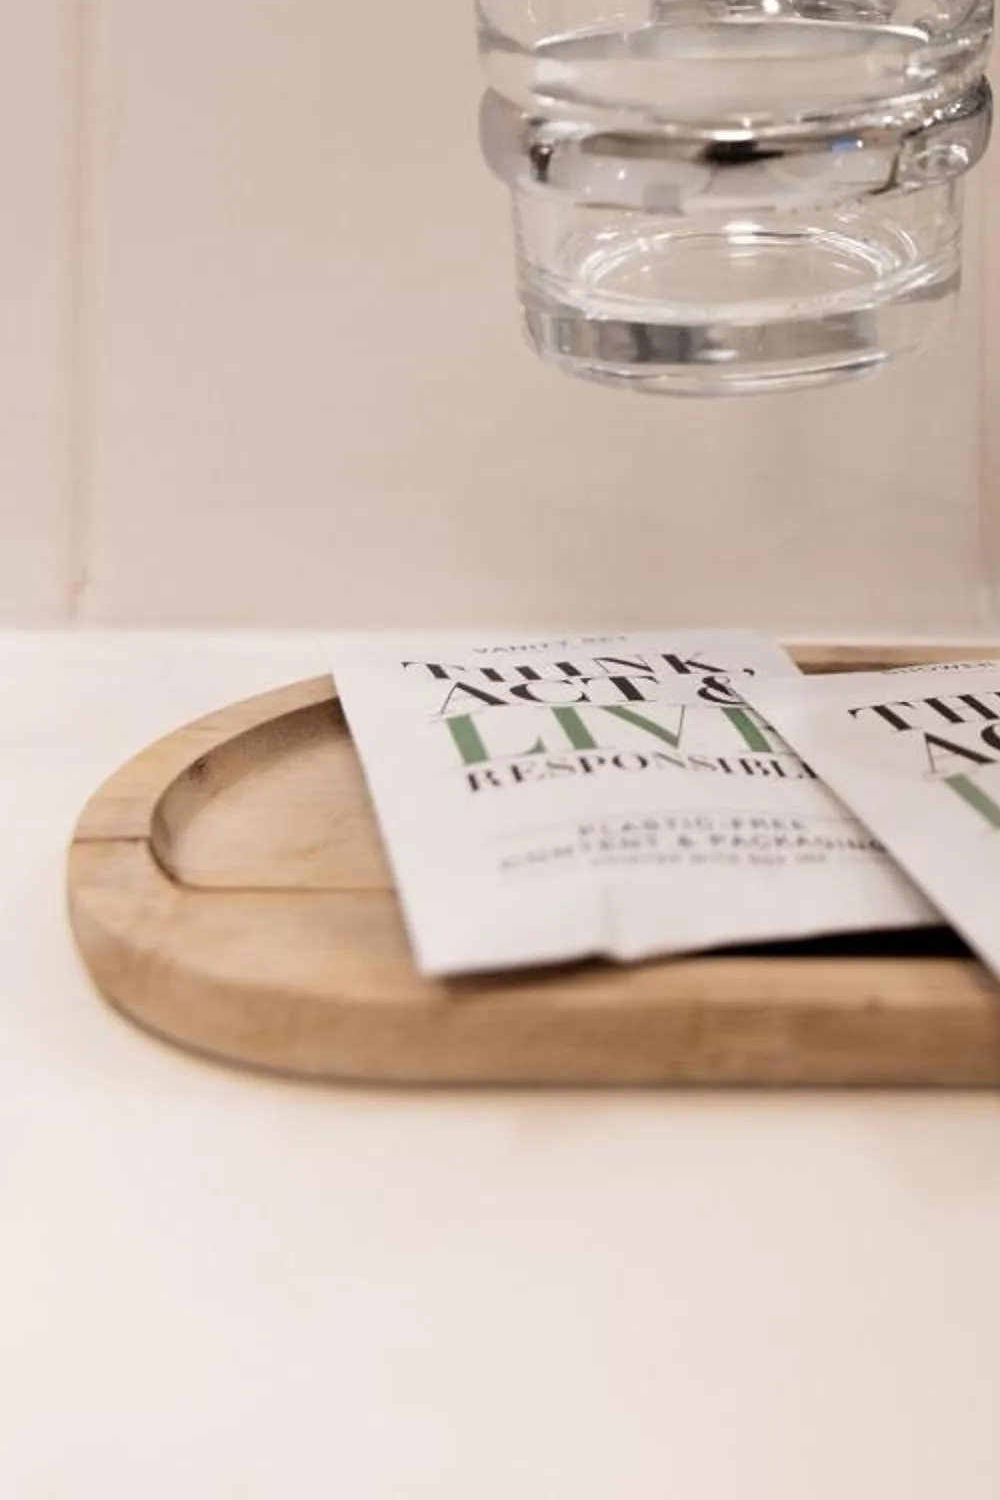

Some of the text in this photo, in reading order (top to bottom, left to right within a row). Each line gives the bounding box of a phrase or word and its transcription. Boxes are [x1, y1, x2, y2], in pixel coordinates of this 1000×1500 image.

[401, 652, 756, 683] THINK,
[432, 675, 747, 720] ACT &
